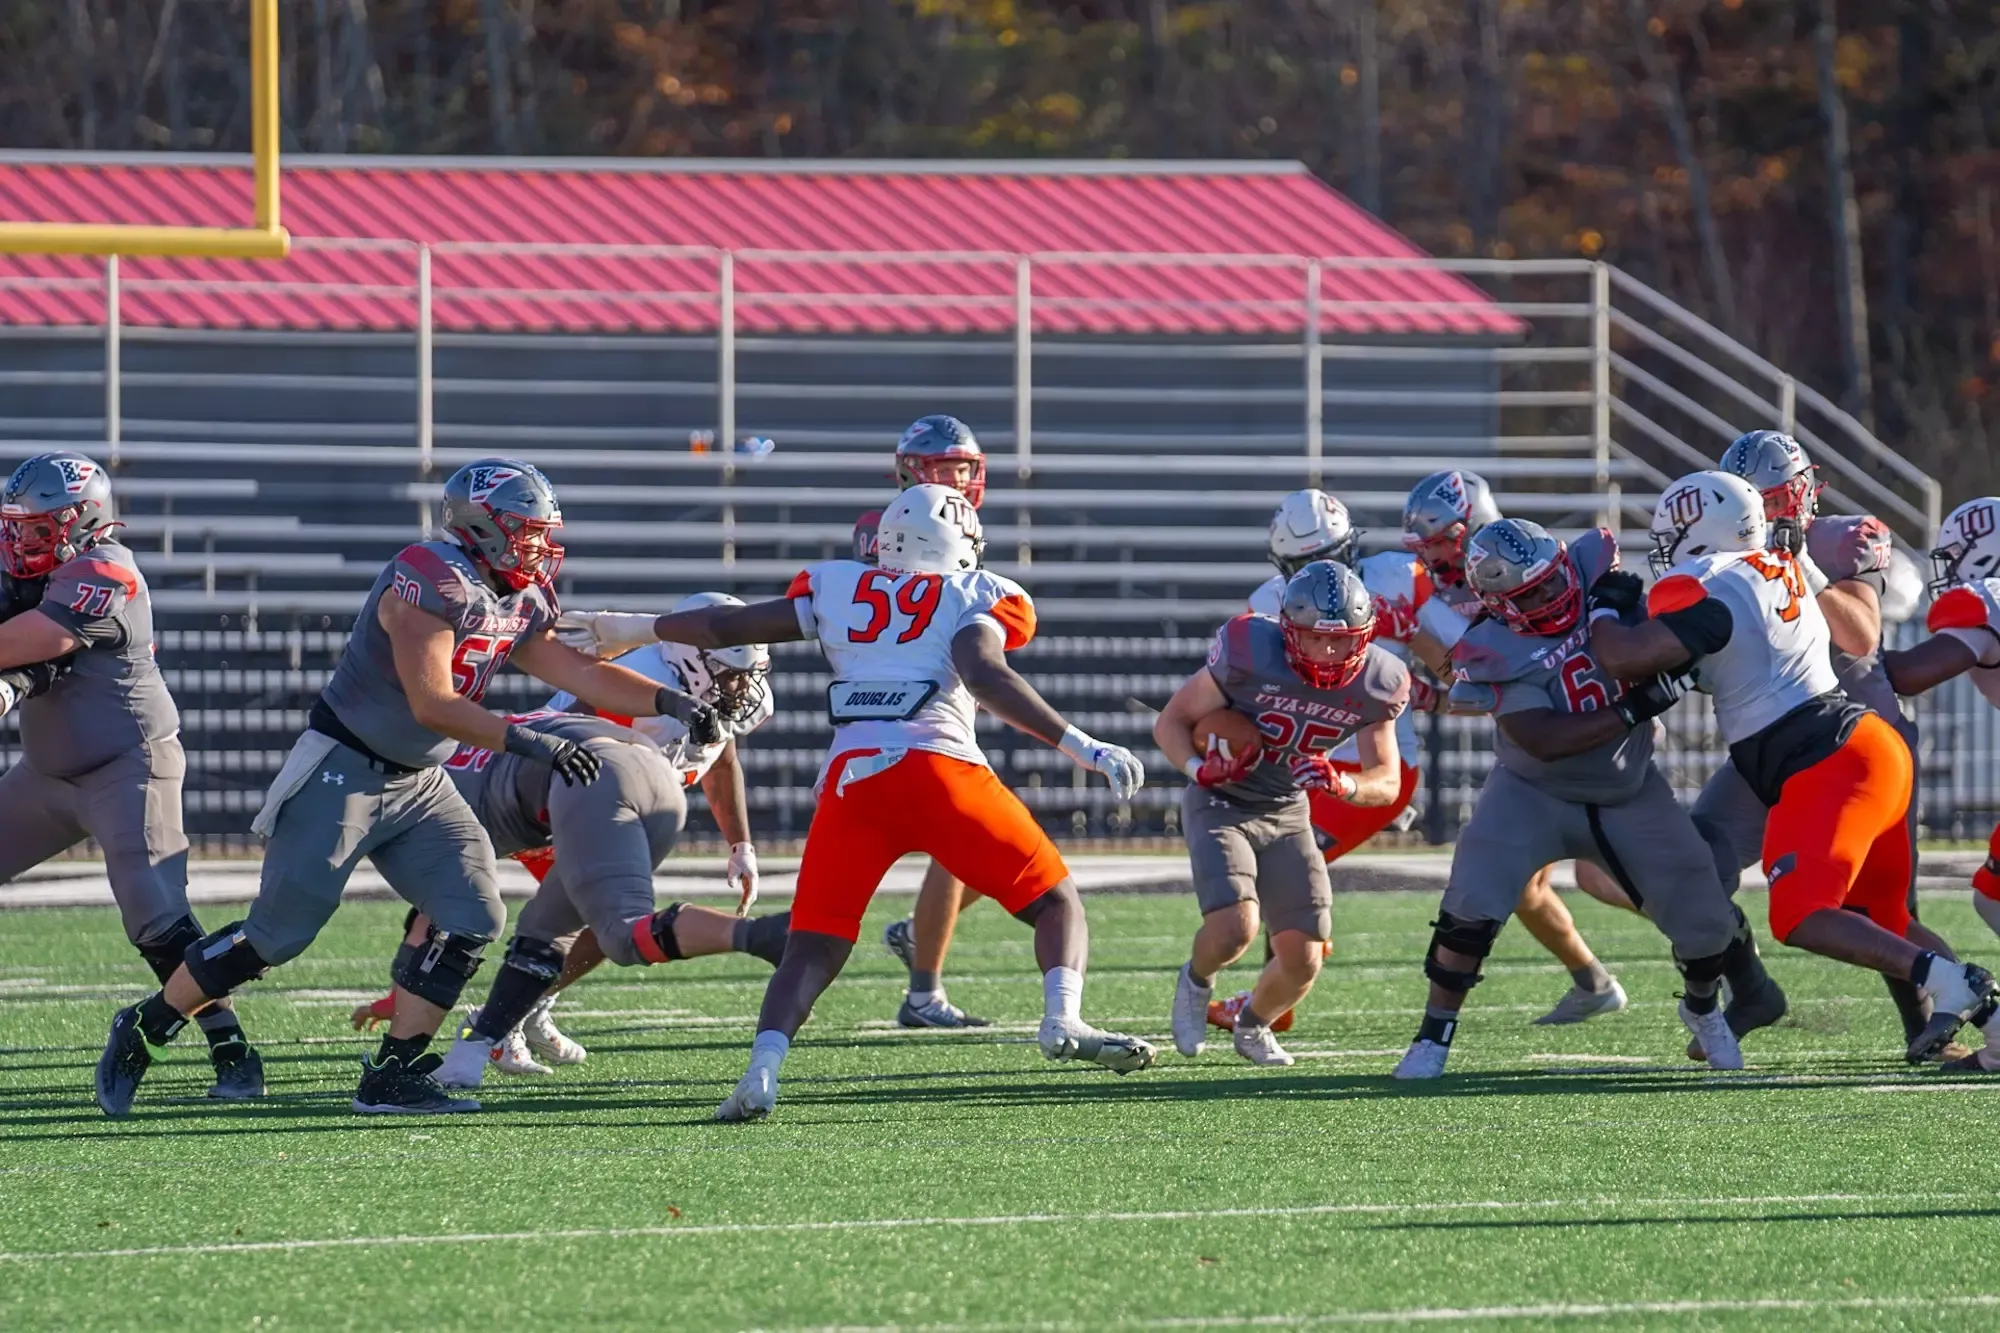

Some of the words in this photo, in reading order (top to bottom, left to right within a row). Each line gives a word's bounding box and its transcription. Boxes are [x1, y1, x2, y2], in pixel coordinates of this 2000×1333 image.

[71, 582, 116, 618] 77
[847, 569, 945, 644] 59
[844, 691, 906, 707] DOUGLAS
[1256, 710, 1346, 766] 25
